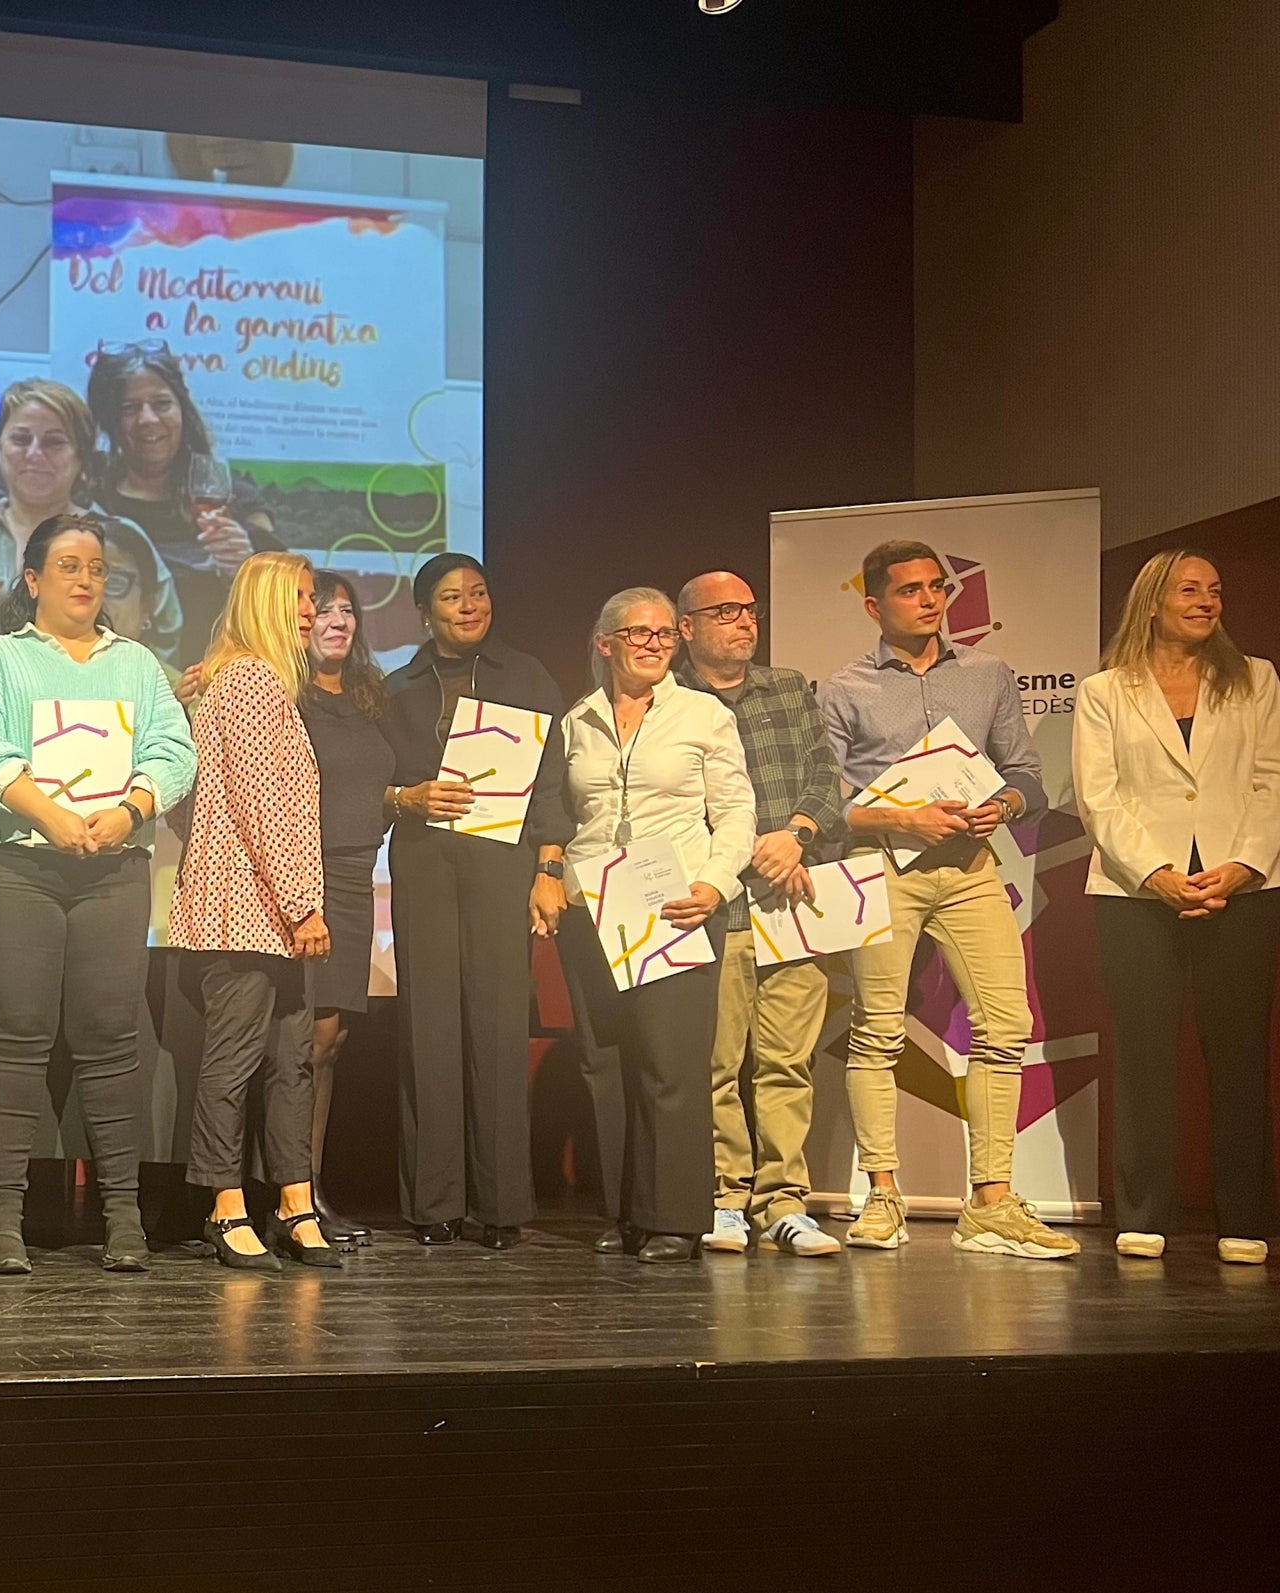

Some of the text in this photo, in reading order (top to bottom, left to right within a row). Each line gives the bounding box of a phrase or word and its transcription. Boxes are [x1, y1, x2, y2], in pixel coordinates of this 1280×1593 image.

[69, 254, 323, 305] Del Mediterrani
[145, 300, 378, 354] a la garnatxa
[1011, 669, 1076, 691] sme
